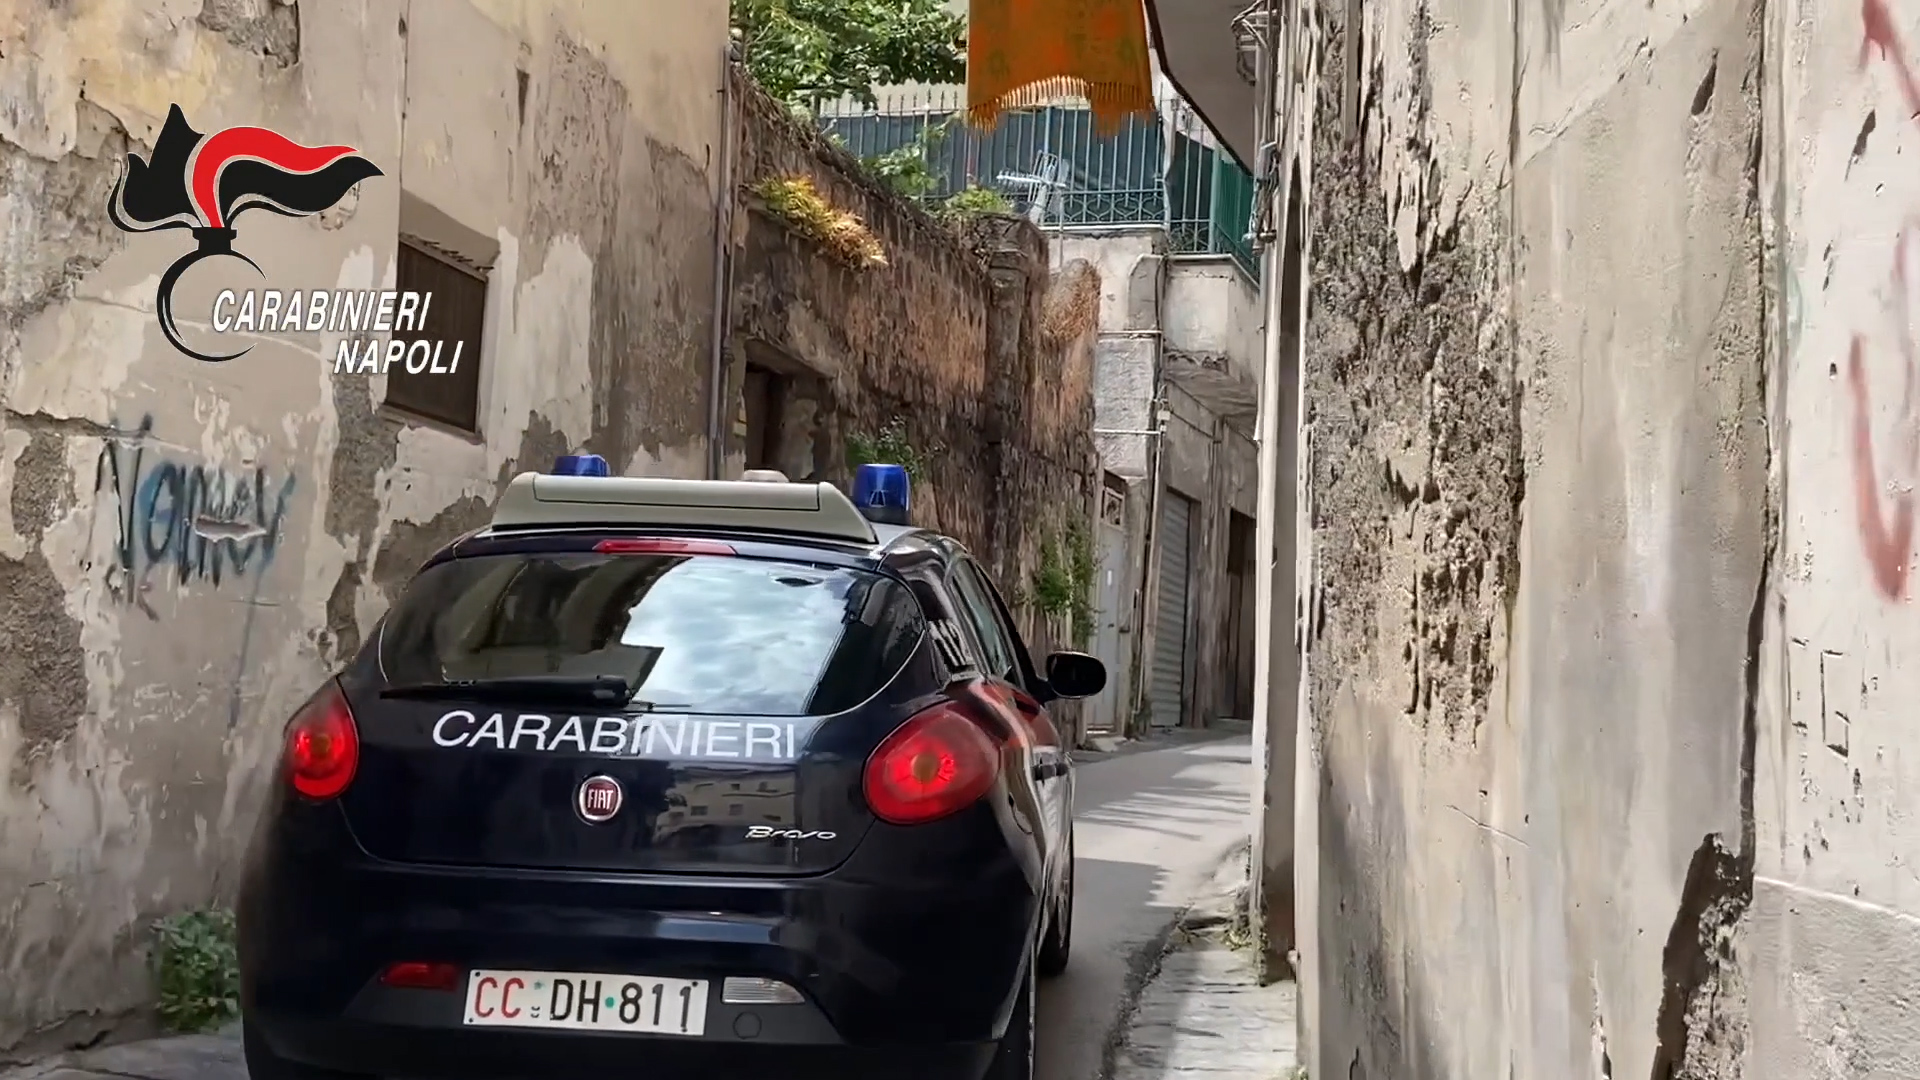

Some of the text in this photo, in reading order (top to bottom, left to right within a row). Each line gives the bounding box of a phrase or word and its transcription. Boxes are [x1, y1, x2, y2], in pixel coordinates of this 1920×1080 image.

[432, 709, 795, 759] CARABINIERI
[587, 788, 614, 810] FIAT
[474, 976, 525, 1019] CC
